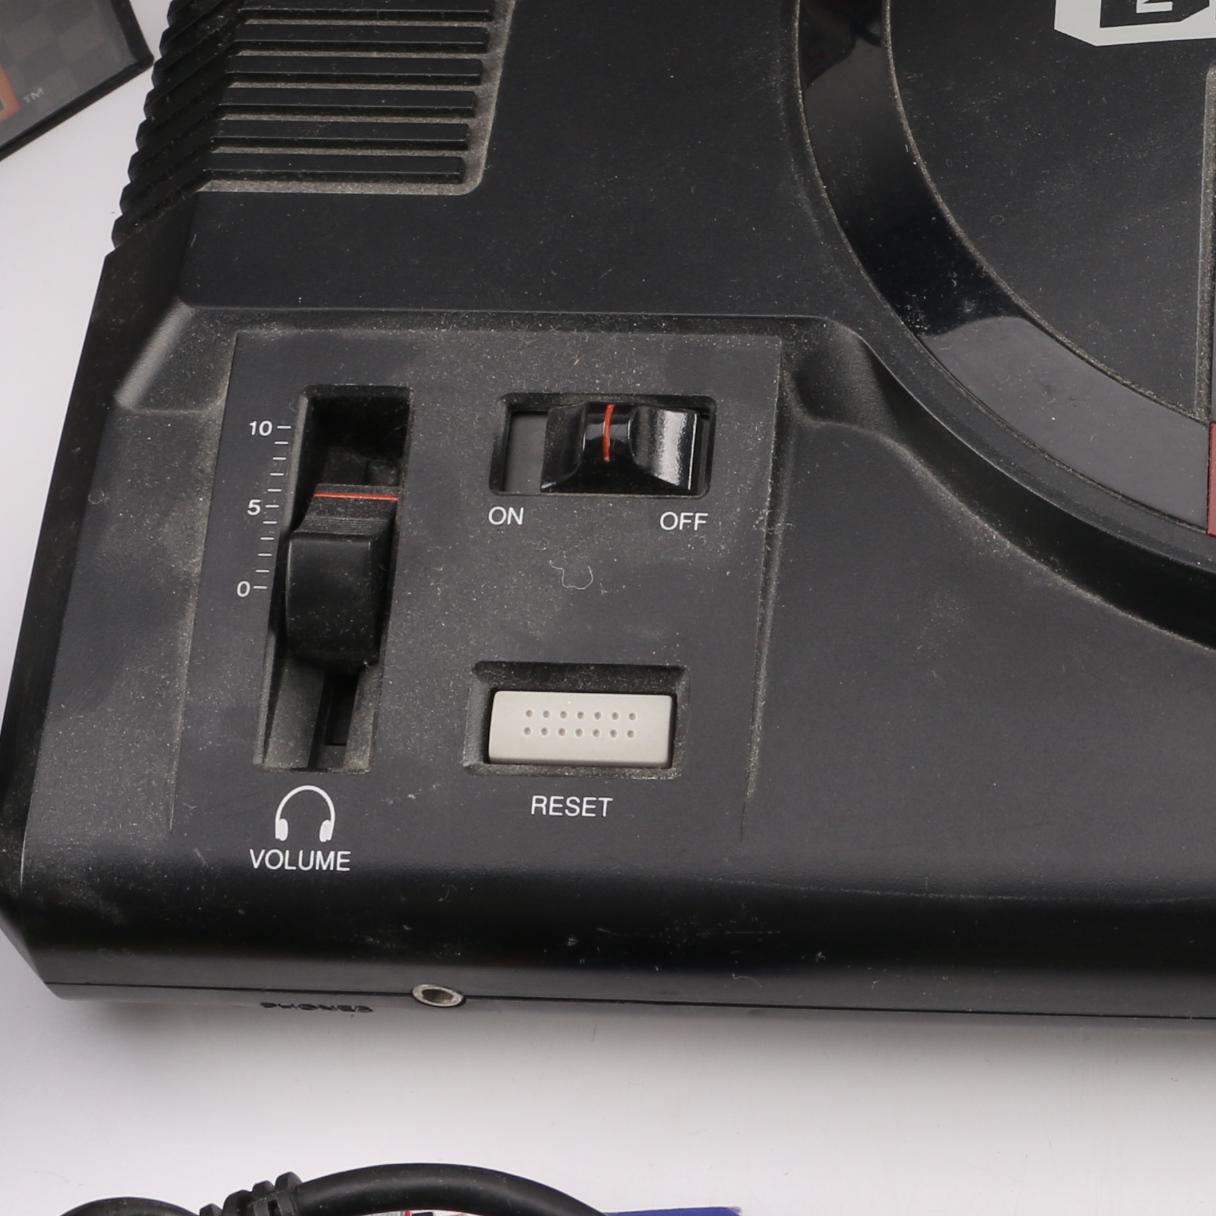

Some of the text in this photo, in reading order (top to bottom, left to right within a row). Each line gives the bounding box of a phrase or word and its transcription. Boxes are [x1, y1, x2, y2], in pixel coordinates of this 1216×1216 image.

[247, 420, 274, 437] 10
[246, 498, 261, 516] 5
[488, 506, 525, 526] ON
[659, 511, 709, 532] OFF
[235, 580, 251, 599] 0
[530, 794, 614, 818] RESET
[249, 848, 352, 872] VOLUME
